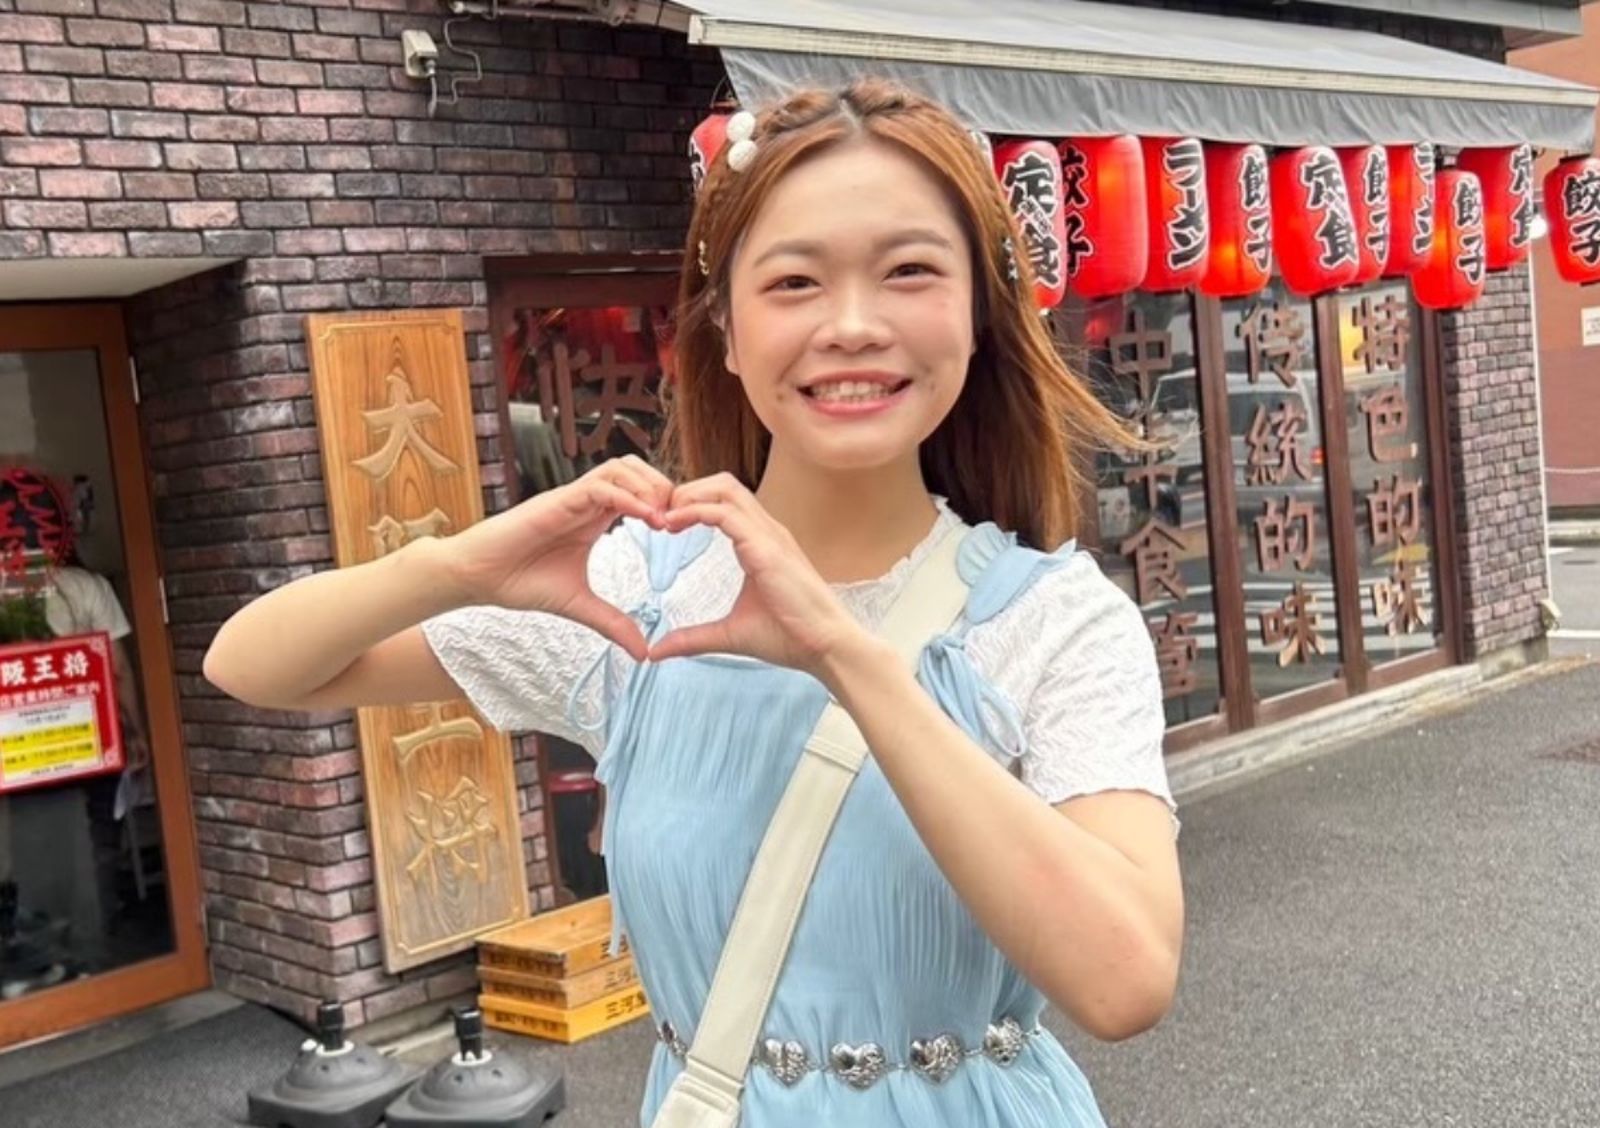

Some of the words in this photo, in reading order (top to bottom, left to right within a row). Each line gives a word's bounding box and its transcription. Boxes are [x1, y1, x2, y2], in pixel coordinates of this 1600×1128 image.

[1004, 151, 1060, 287] 定食
[1164, 139, 1207, 269] ラーメン
[1302, 151, 1358, 267] 定食
[1563, 168, 1600, 264] 餃子
